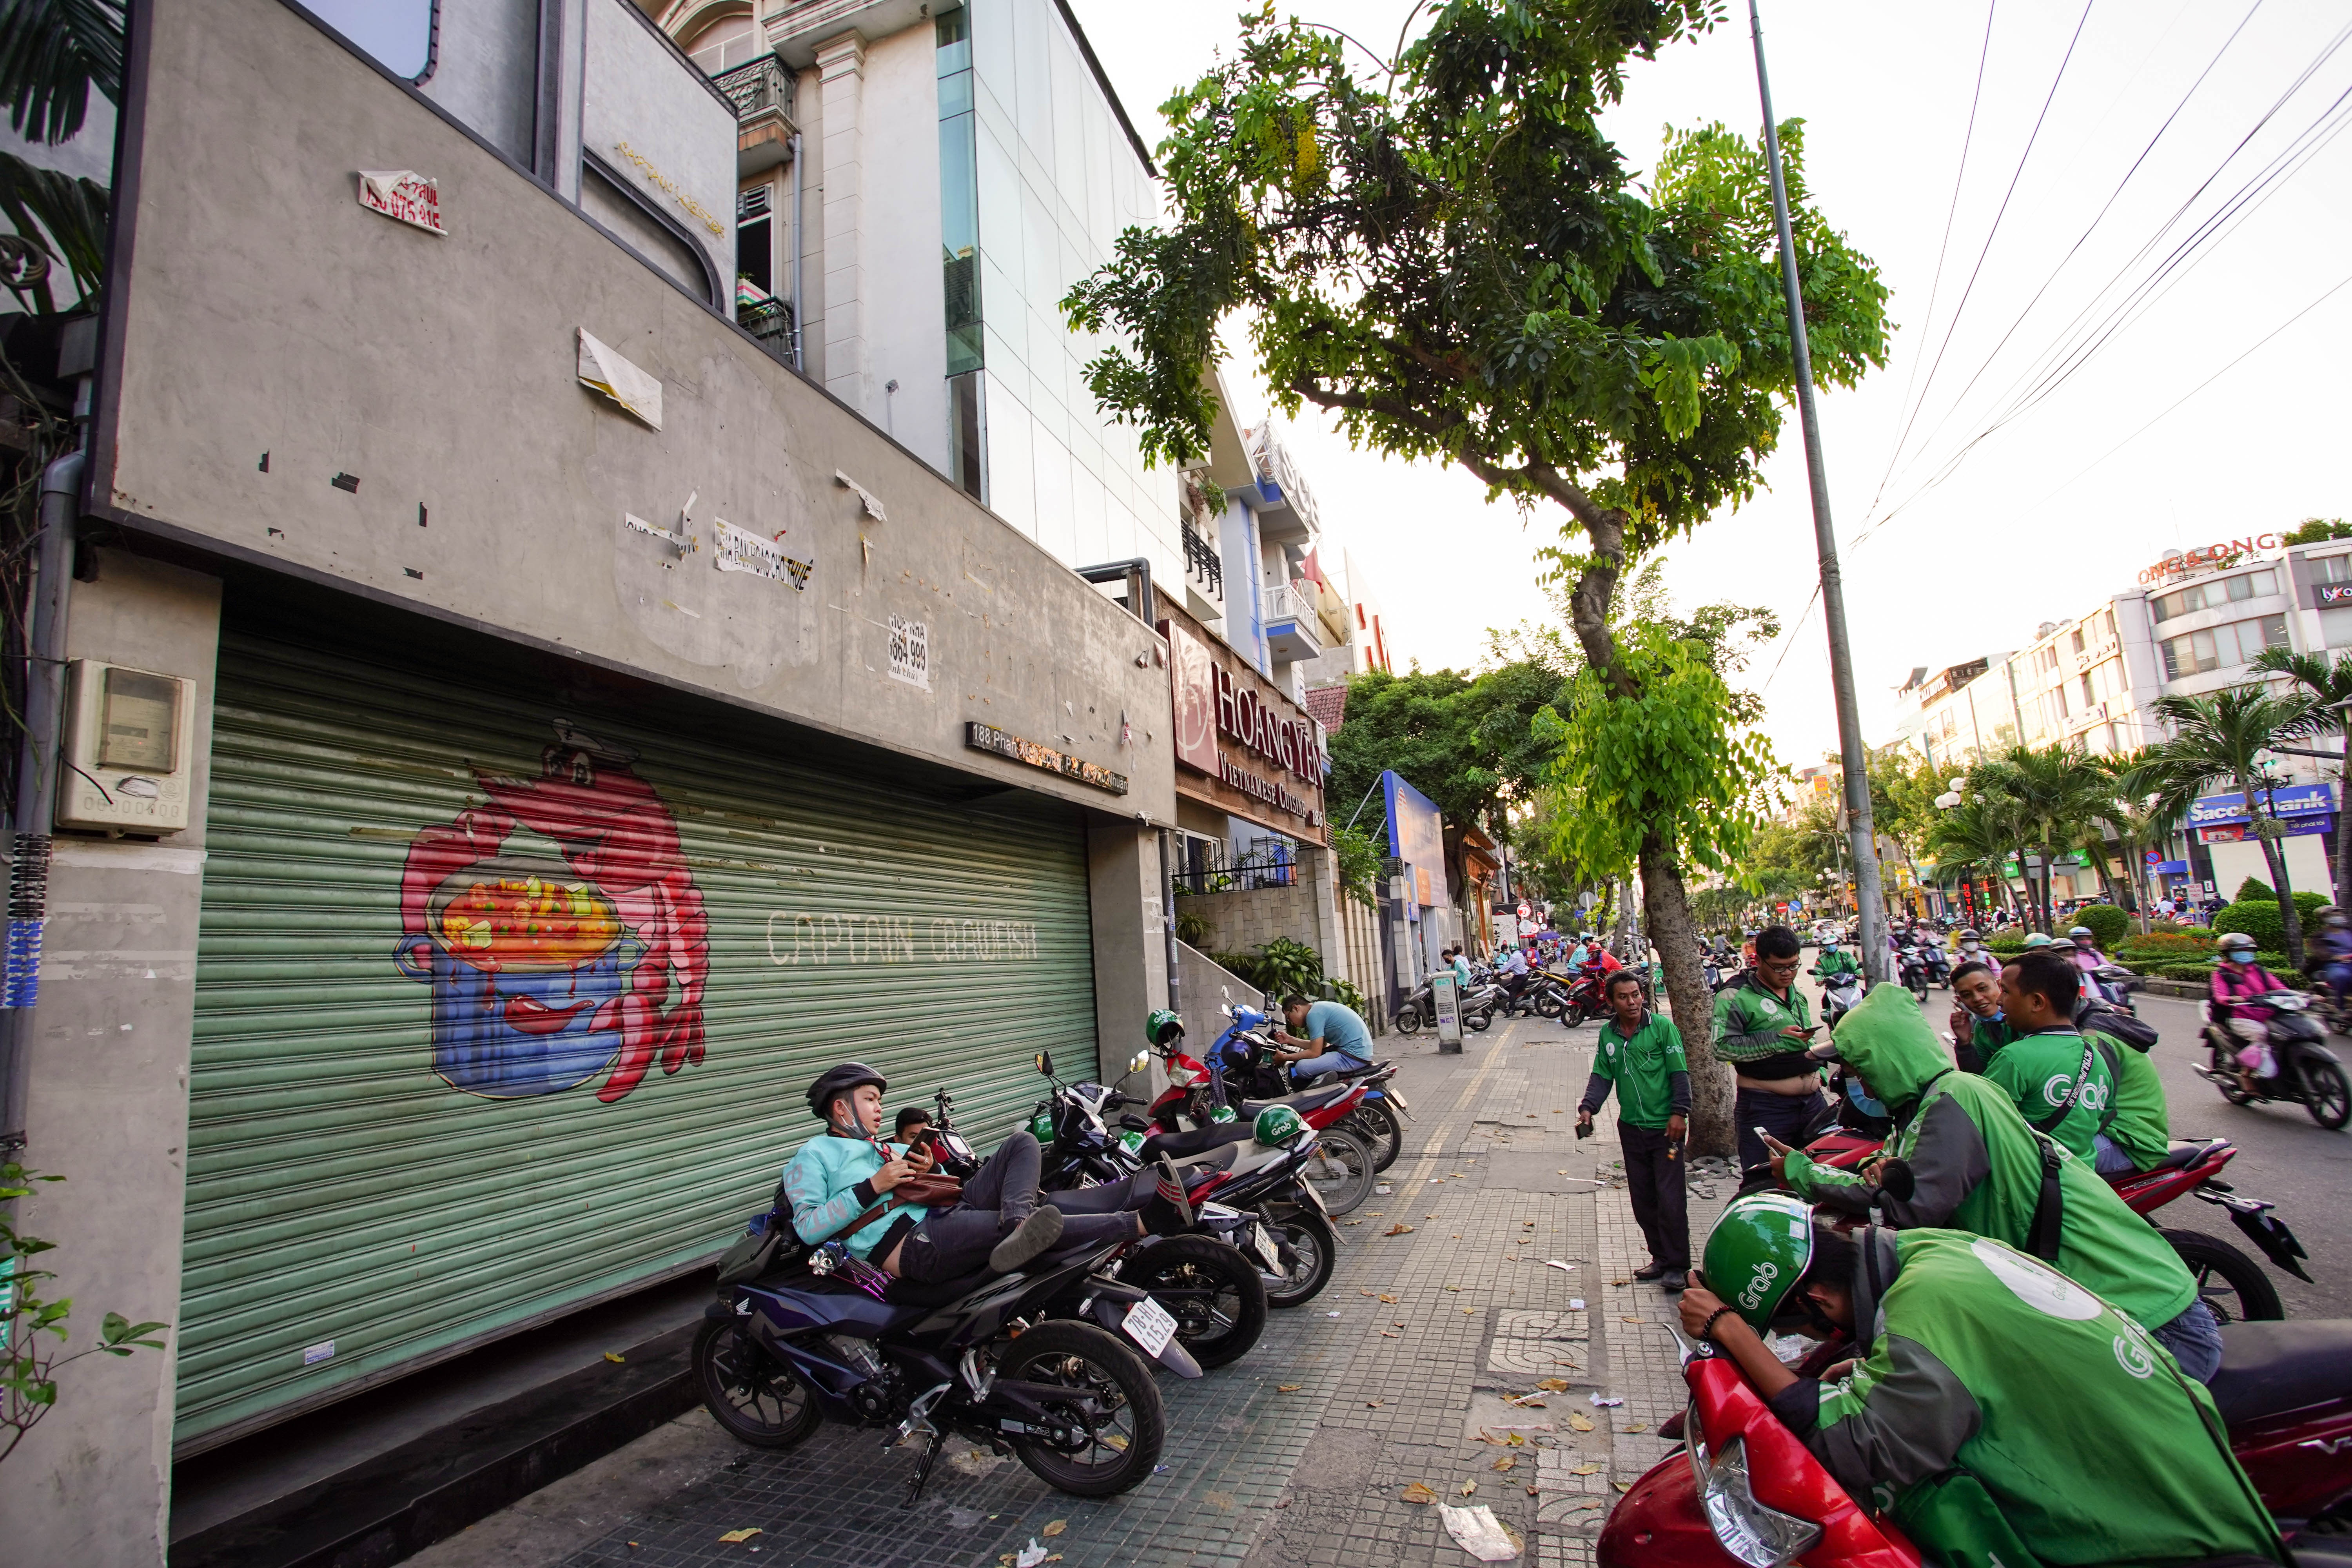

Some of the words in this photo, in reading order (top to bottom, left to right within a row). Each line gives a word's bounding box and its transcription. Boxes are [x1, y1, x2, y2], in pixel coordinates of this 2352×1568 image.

[788, 559, 813, 590] THUÊ
[2138, 557, 2181, 585] ONG
[2186, 551, 2203, 567] &
[2208, 533, 2276, 559] ONG
[911, 636, 926, 671] 999
[973, 724, 991, 744] 188
[994, 731, 1017, 753] Phan
[1214, 661, 1293, 769] HOÀNG
[1292, 720, 1324, 789] YÊN
[1219, 750, 1276, 805] VIETNAMESE
[1279, 782, 1307, 818] CUISINE
[1312, 809, 1323, 828] 186
[767, 910, 914, 965] CAPTAIN
[1154, 1011, 1172, 1024] Grab
[1768, 1013, 1784, 1022] Grab
[1666, 1044, 1683, 1054] Grab
[2043, 1073, 2109, 1111] Gab
[1271, 1122, 1292, 1136] Grab
[1738, 1261, 1778, 1310] Grab
[1127, 1301, 1156, 1335] 78-H1
[1142, 1312, 1174, 1352] 415.29
